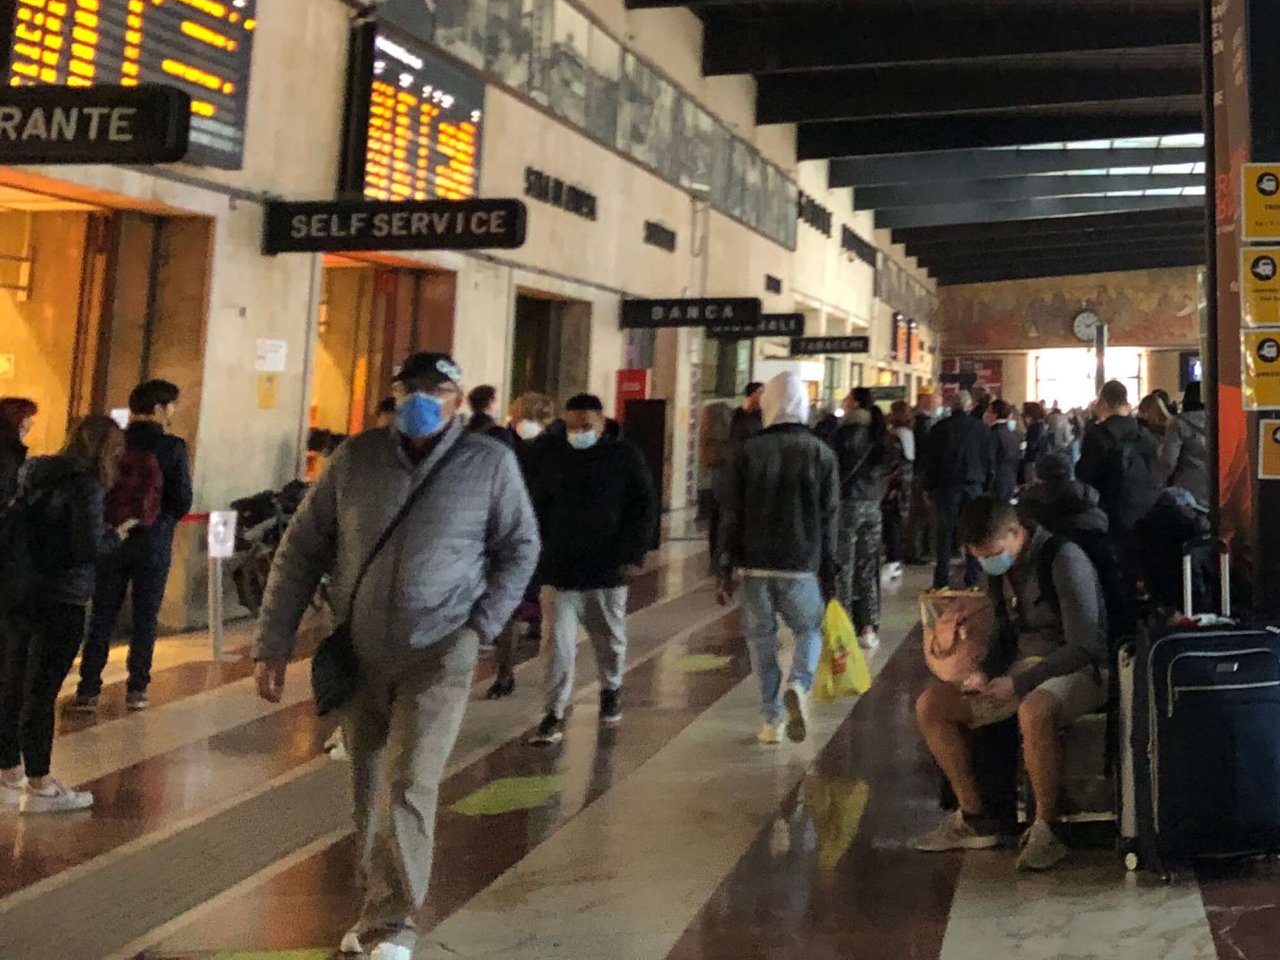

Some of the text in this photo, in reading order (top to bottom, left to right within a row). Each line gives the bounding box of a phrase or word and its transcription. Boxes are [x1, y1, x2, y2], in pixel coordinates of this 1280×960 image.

[0, 107, 138, 141] RANTE
[290, 210, 507, 238] SELF SERVICE
[651, 305, 734, 321] BANCA
